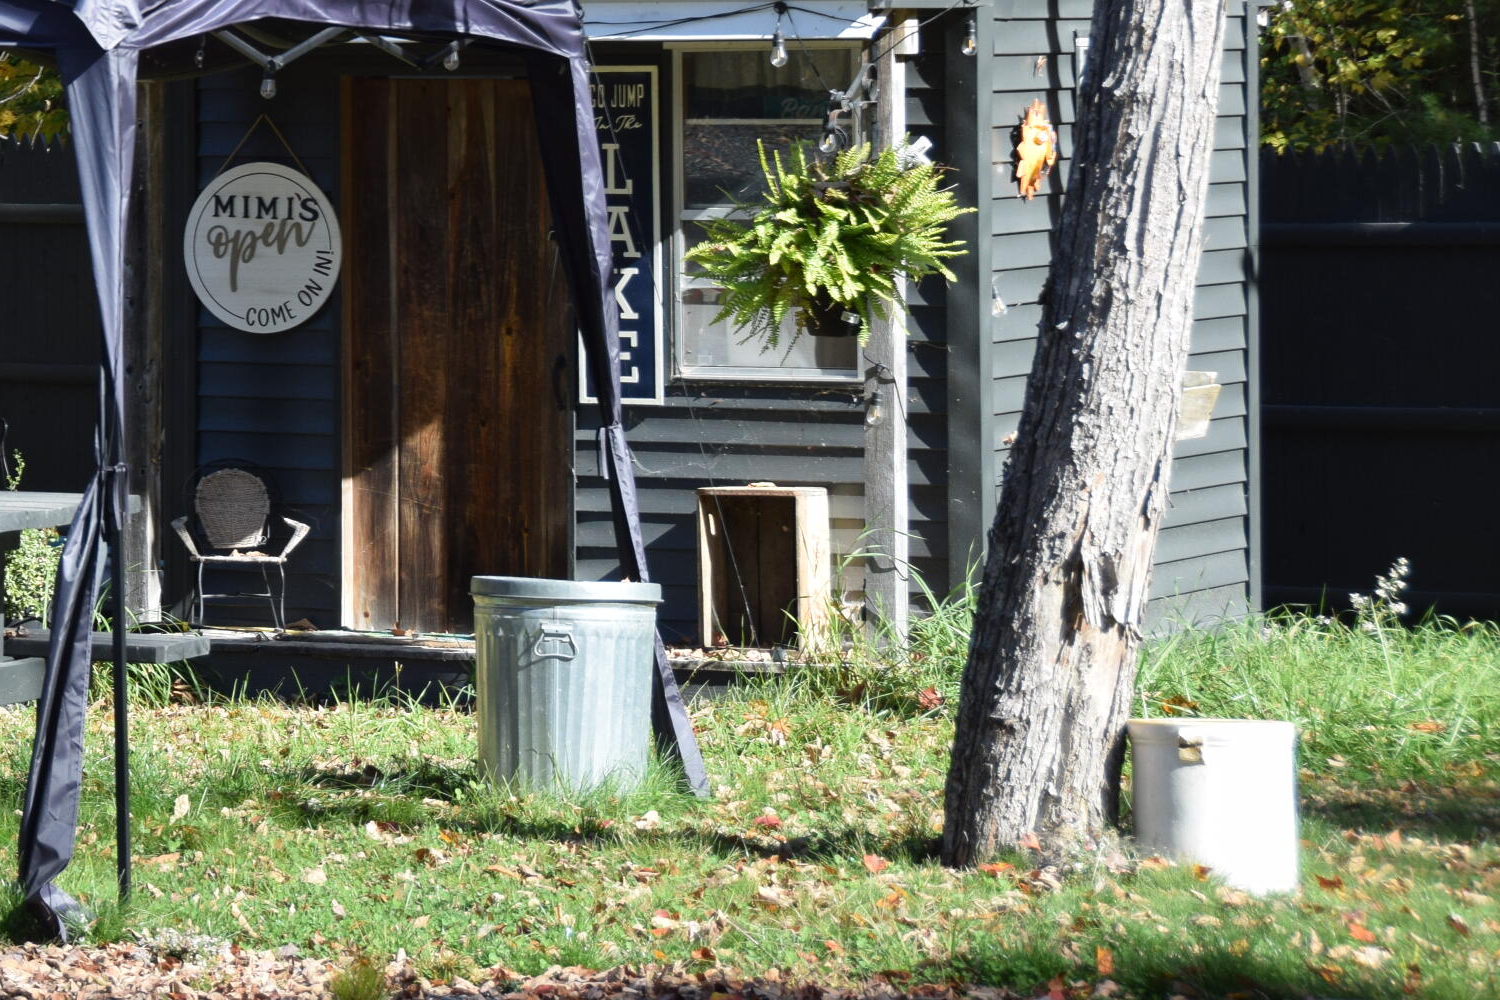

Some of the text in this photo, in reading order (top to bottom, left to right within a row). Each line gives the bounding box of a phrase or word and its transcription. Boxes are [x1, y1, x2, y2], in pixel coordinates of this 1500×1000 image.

[610, 84, 645, 108] JUMP
[612, 114, 643, 133] The
[212, 193, 320, 222] MIMI'S
[207, 219, 317, 292] open
[246, 250, 335, 327] COME ON IN!
